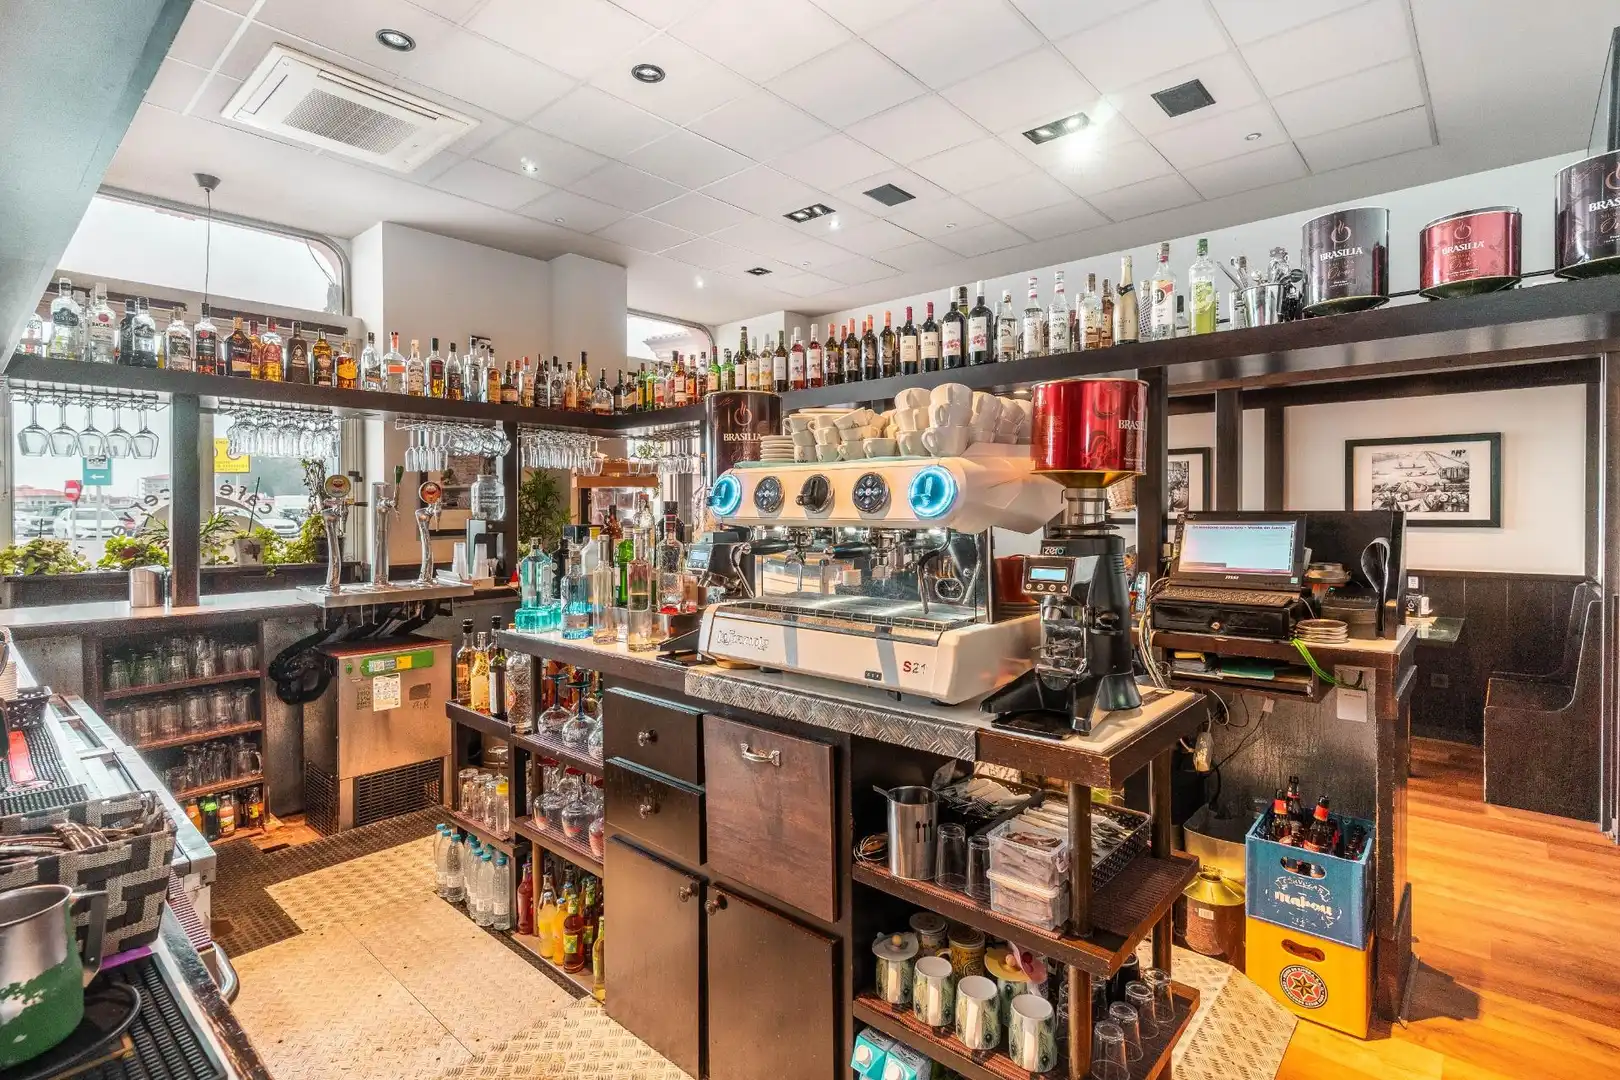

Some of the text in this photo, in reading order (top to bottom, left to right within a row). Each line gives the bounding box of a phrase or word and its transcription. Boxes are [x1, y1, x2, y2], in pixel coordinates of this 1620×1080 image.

[1320, 246, 1364, 261] BRASILIA
[1441, 240, 1485, 256] BRASILIA
[1274, 891, 1333, 917] mahou
